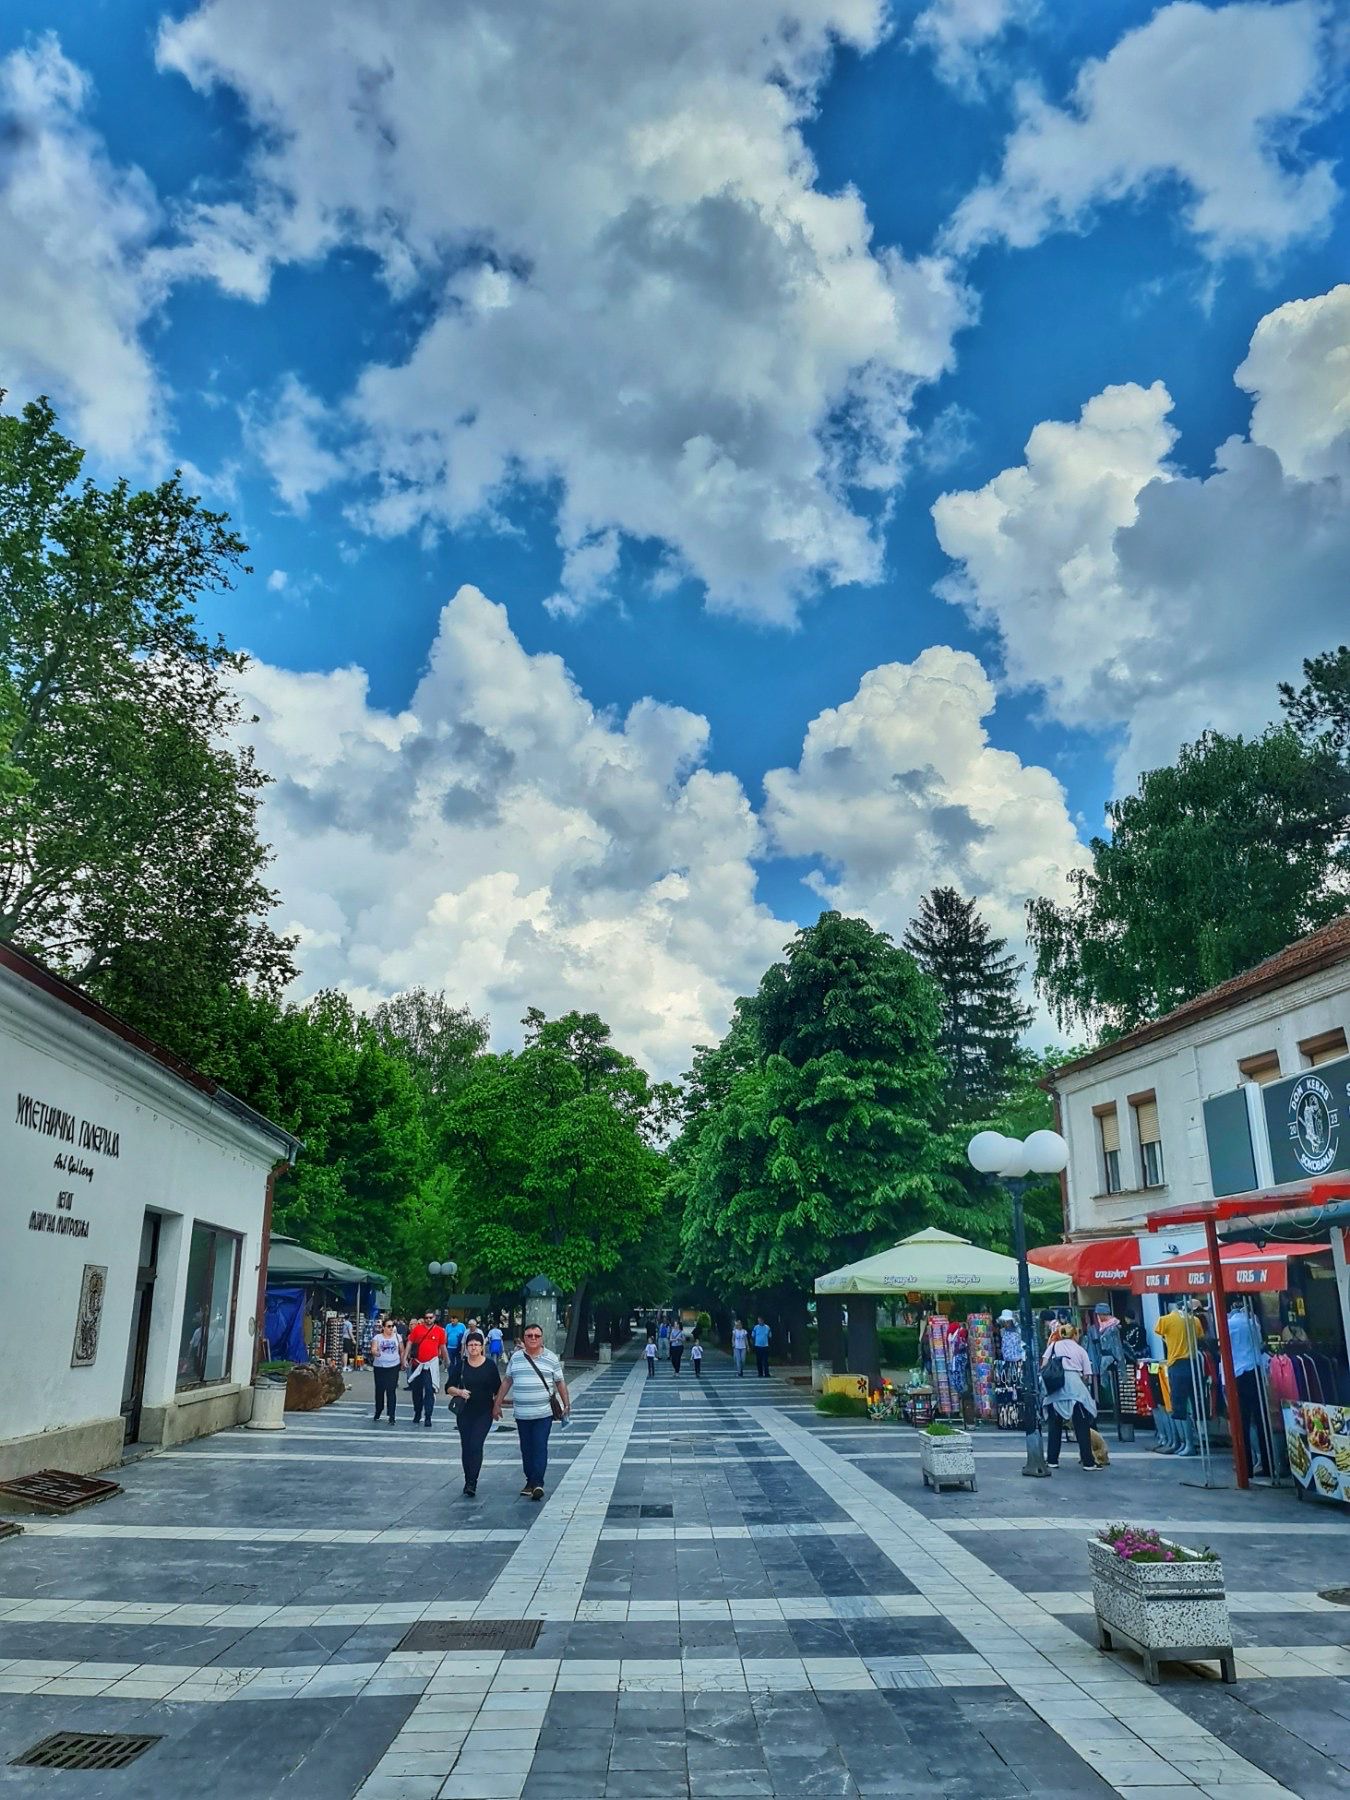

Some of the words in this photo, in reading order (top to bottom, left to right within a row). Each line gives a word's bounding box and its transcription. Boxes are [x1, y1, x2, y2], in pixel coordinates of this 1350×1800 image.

[1291, 1085, 1304, 1111] DON
[1306, 1079, 1330, 1101] KEBAB
[67, 1155, 94, 1183] Gallery
[1301, 1148, 1335, 1171] SOKOBANJA
